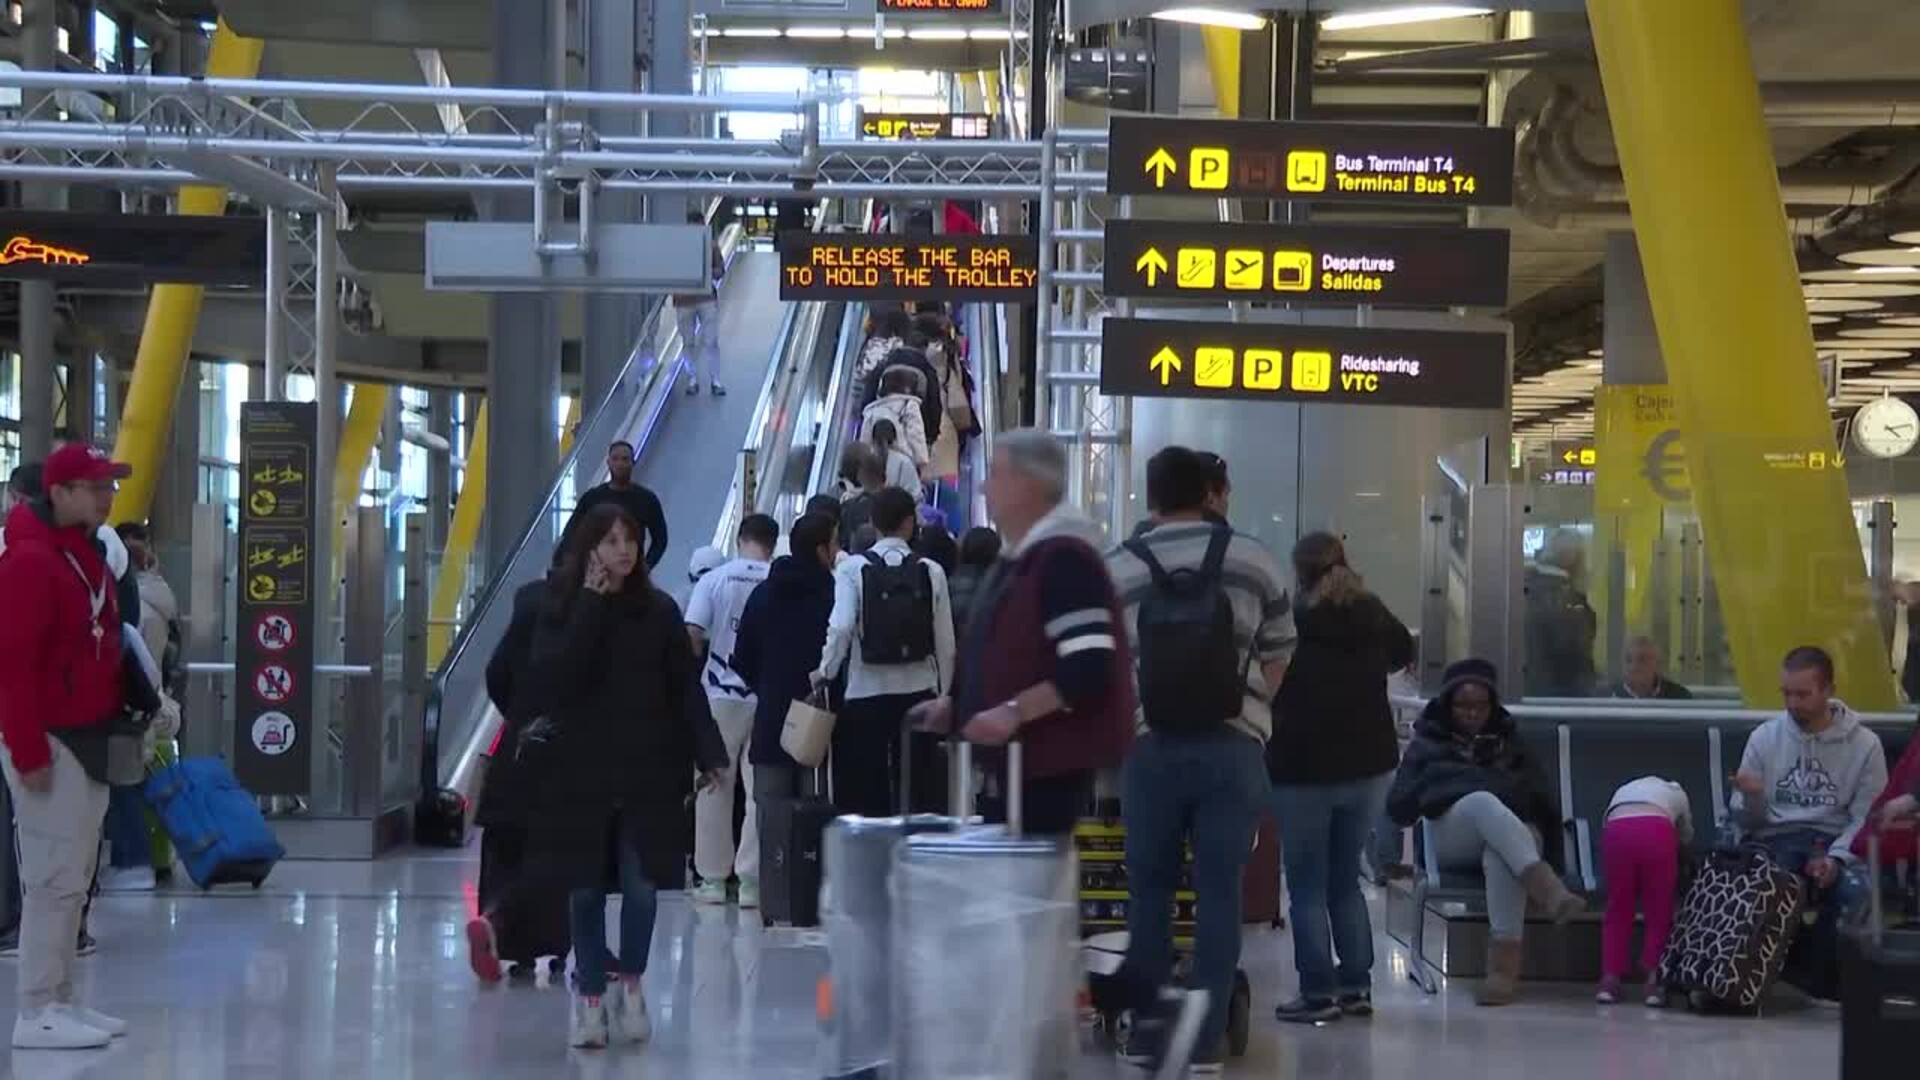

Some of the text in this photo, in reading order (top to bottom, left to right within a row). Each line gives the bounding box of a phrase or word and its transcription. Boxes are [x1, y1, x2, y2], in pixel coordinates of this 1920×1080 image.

[1335, 155, 1454, 173] Bus Terminal T4
[1336, 173, 1475, 193] Terminal Bus T4
[812, 248, 1011, 267] RELEASE THE BAR
[1322, 254, 1395, 273] Departures
[786, 267, 1037, 287] TO HOLD THE TROLLEY
[1322, 273, 1382, 291] Salidas
[1341, 354, 1420, 376] Ridesharing
[1341, 373, 1378, 391] VTC
